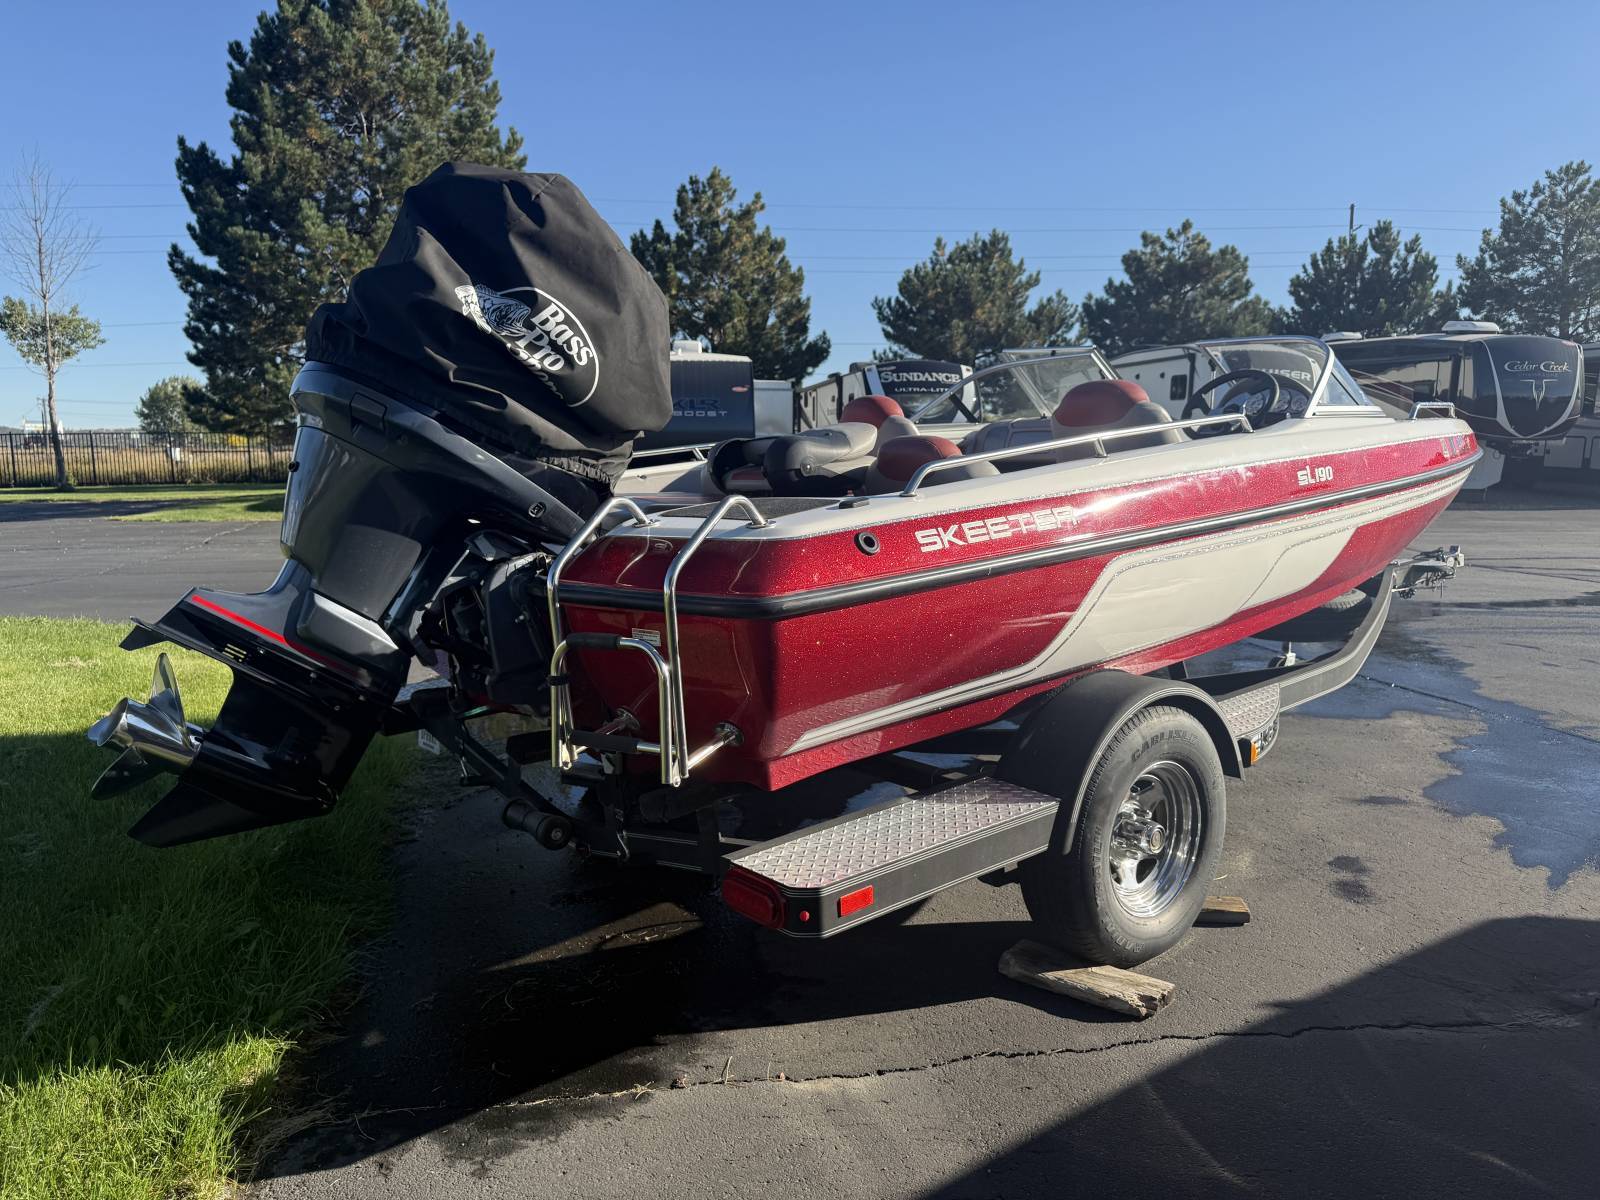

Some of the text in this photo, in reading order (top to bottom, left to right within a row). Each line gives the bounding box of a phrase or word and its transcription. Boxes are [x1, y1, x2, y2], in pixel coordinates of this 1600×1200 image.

[515, 326, 565, 371] Pro
[530, 302, 594, 366] Bass
[880, 371, 961, 384] SUNDANCE
[1504, 361, 1573, 373] Cedar Creek
[914, 505, 1081, 553] SKEETER
